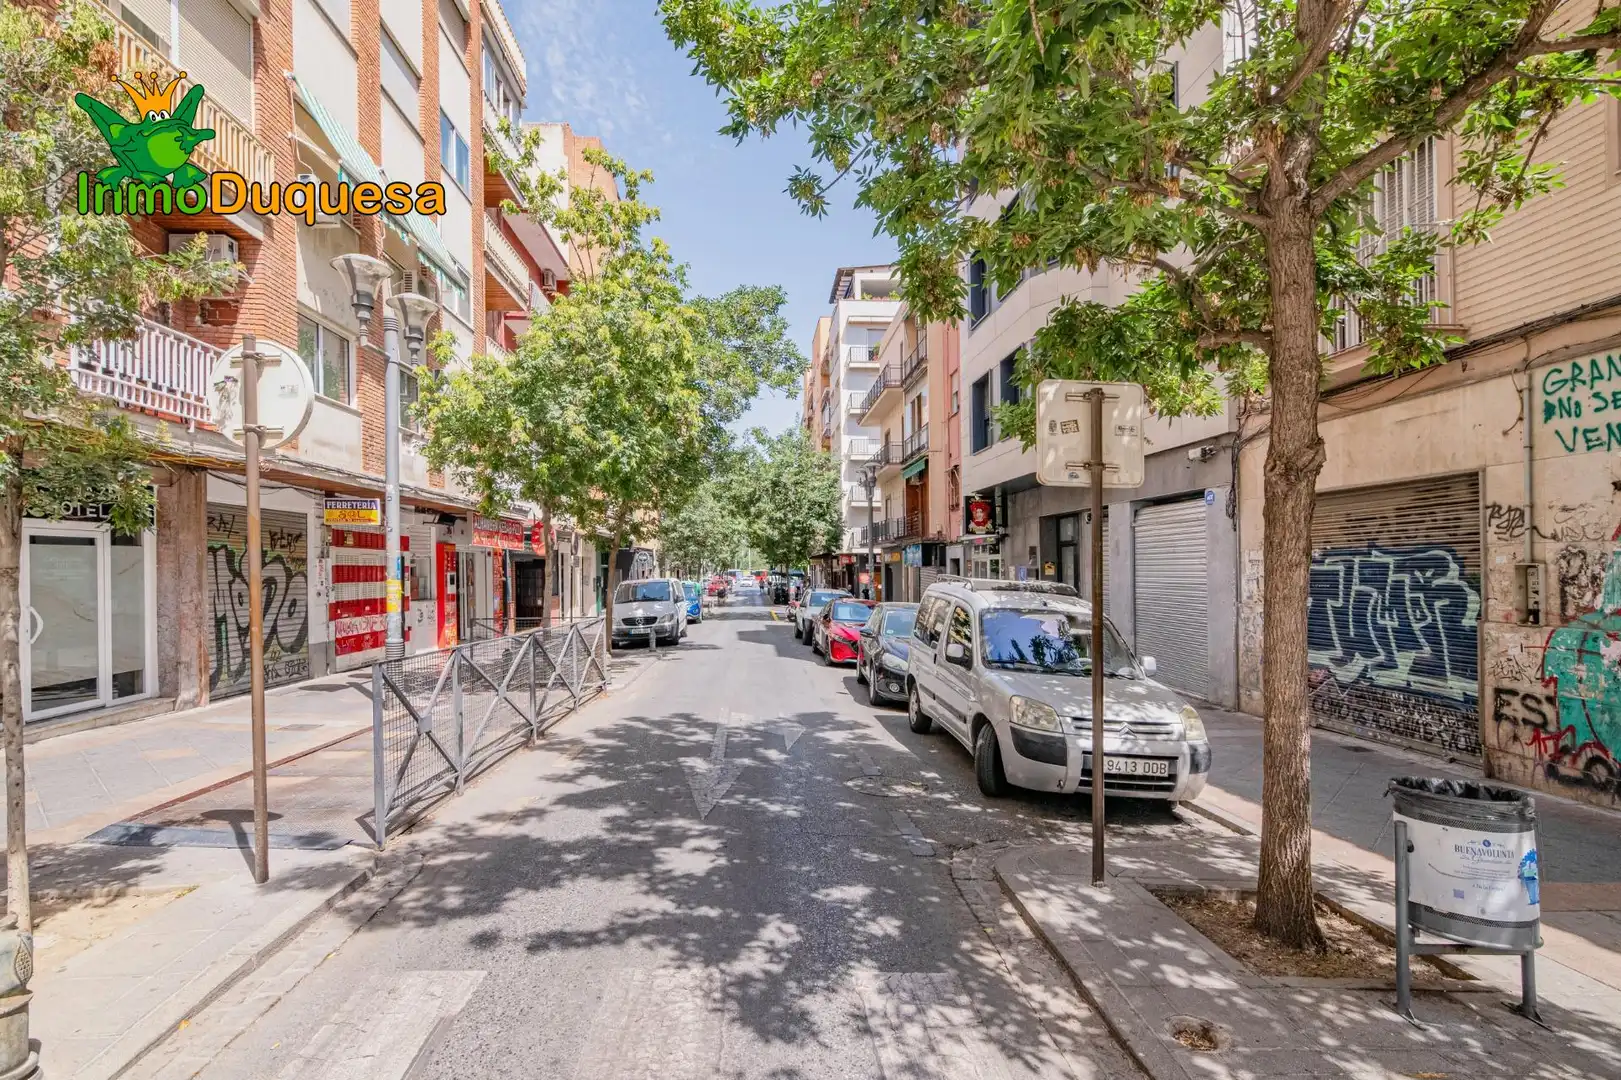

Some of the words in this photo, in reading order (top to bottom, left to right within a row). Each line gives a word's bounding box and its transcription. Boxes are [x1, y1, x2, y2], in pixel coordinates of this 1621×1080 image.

[1557, 396, 1582, 419] NO
[326, 500, 377, 510] FERRETERÍA
[338, 510, 366, 519] SOL
[1106, 760, 1138, 774] 9413
